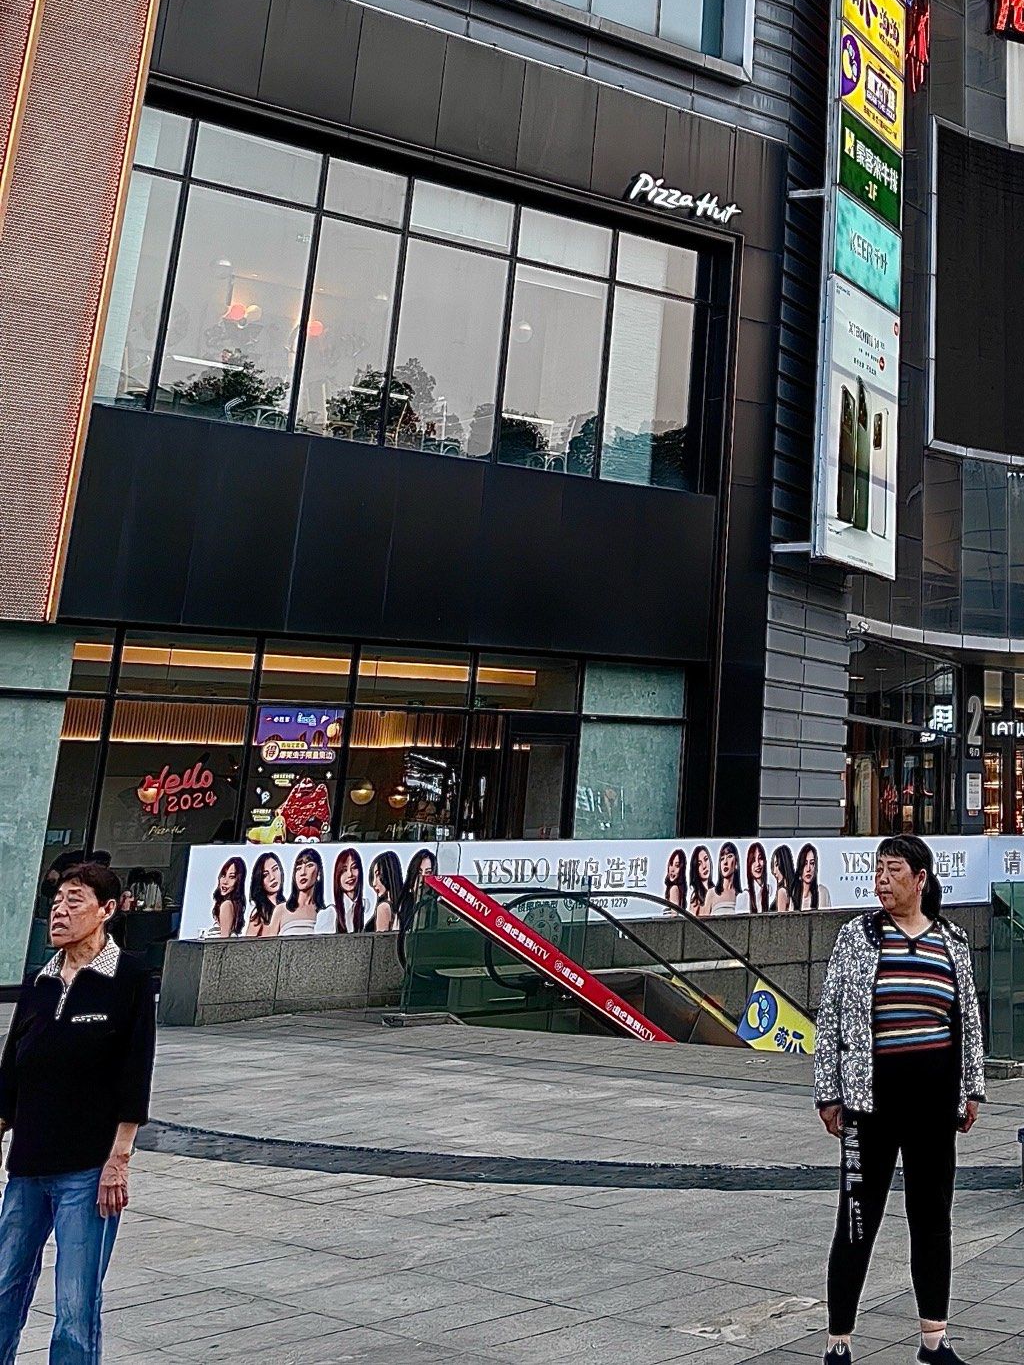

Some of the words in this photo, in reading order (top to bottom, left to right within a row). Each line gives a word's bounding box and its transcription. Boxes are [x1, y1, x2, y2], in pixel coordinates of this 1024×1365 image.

[630, 172, 693, 209] Pizza
[696, 192, 742, 224] Hut
[968, 695, 982, 745] 2
[143, 762, 213, 814] Hello
[168, 791, 217, 811] 2024
[473, 857, 550, 885] YESIDO
[611, 897, 628, 907] 1279
